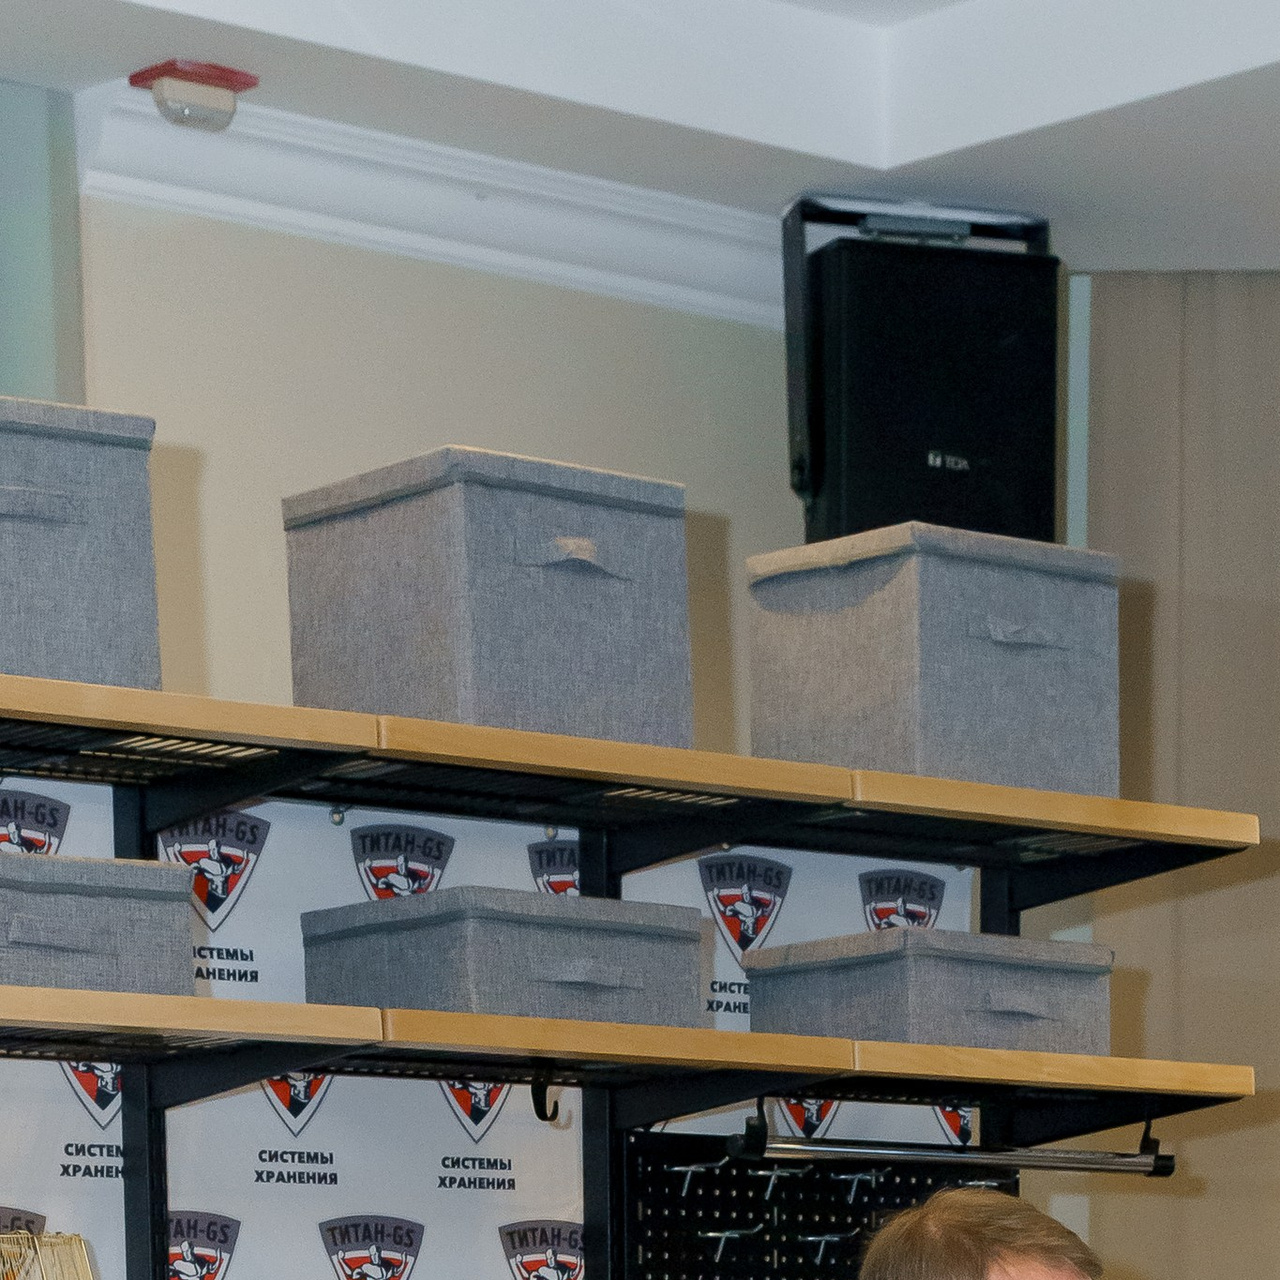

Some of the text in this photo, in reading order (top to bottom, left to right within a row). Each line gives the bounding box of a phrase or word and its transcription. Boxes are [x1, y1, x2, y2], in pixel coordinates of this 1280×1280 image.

[192, 946, 254, 963] СТЕМЫ
[194, 966, 259, 983] АНЕНИЯ
[710, 980, 750, 996] СИСТЕ
[706, 1000, 750, 1015] ХРАНЕ
[258, 1150, 333, 1165] СИСТЕМЫ
[441, 1157, 512, 1171] СИСТЕМЫ
[60, 1164, 125, 1179] ХРАНЕН
[254, 1170, 338, 1185] ХРАНЕНИЯ
[437, 1176, 516, 1190] ХРАНЕНИЯ
[326, 1224, 415, 1249] ТИТАН-GS
